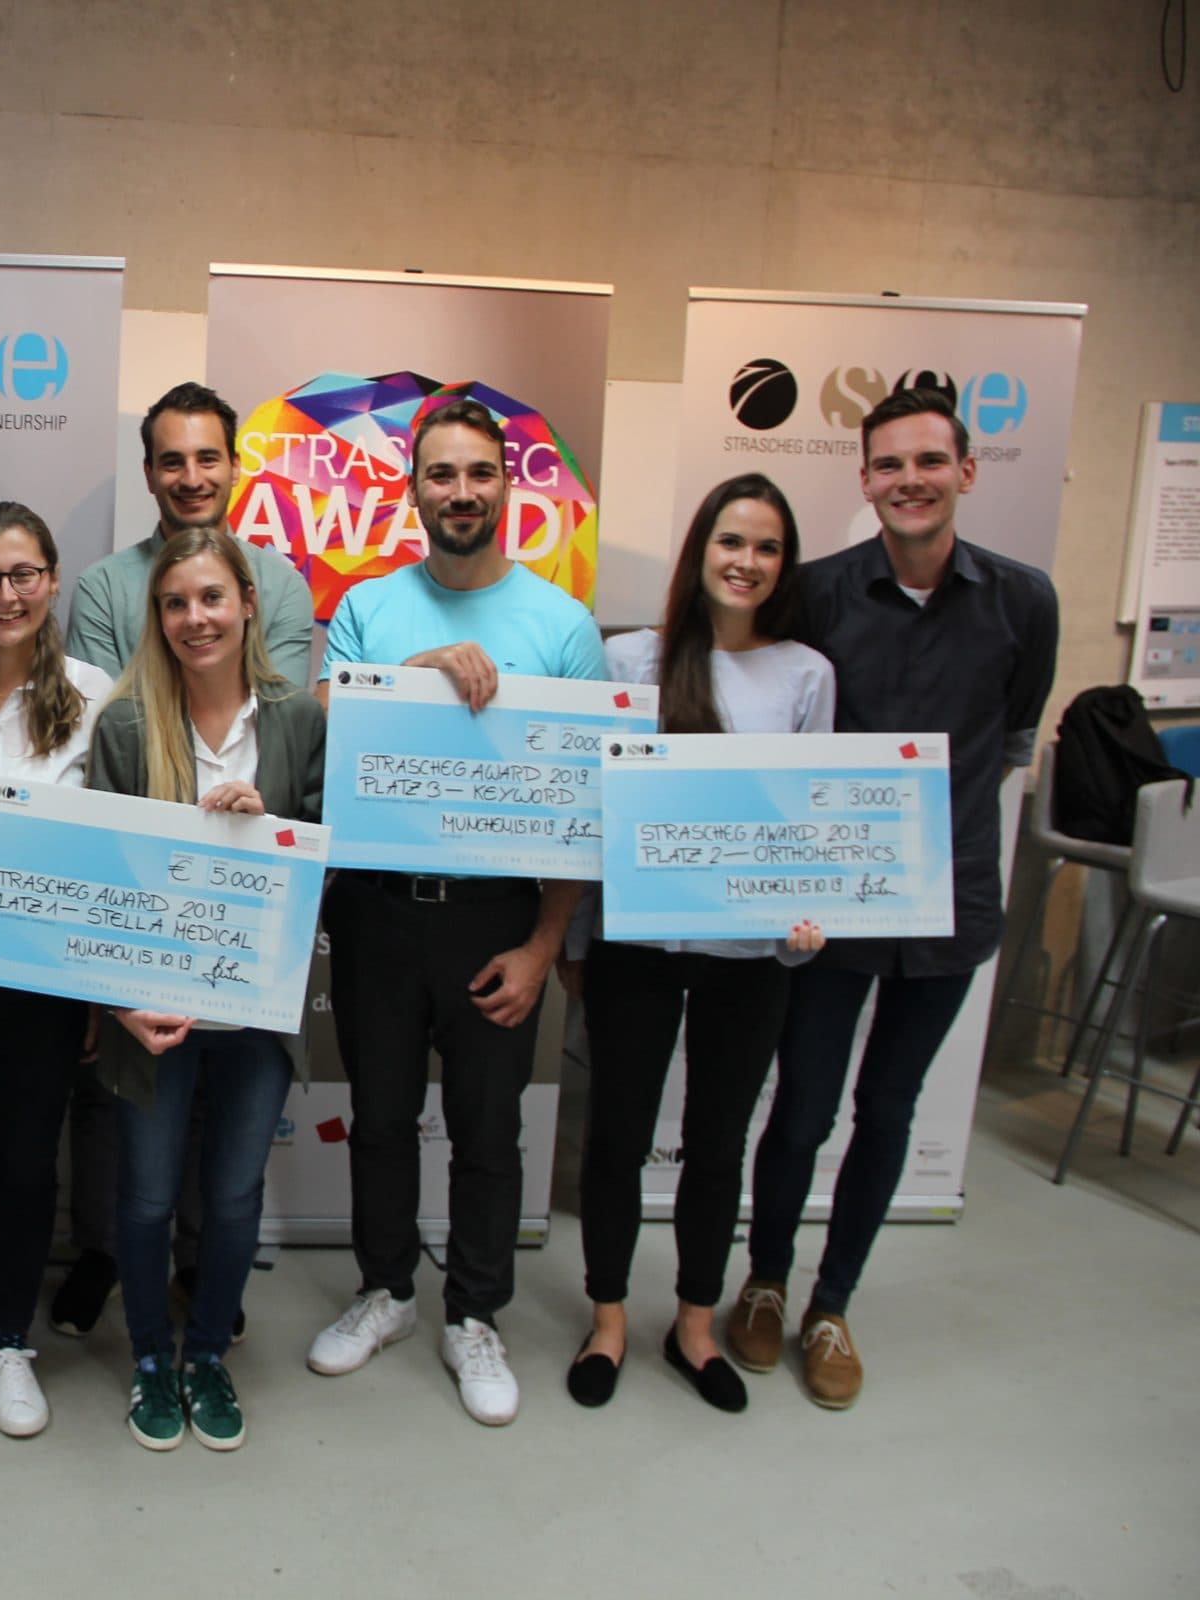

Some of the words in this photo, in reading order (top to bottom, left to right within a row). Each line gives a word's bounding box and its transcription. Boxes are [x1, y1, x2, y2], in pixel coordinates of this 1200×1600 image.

[241, 432, 559, 488] STRASEG
[724, 436, 803, 454] STRASCHEG
[807, 438, 858, 456] CENTER
[235, 482, 561, 562] AWAD
[361, 754, 466, 777] STRASCHEG
[470, 765, 541, 782] AWARD
[549, 768, 589, 785] 2019
[360, 776, 422, 796] PLATZ
[427, 780, 442, 798] 3
[473, 785, 576, 805] KEYWORD
[640, 824, 747, 842] STRASCHEG
[753, 824, 819, 842] AWARD
[827, 824, 871, 842] 2019
[640, 846, 702, 865] PLATZ
[753, 844, 897, 864] ORTHOMETRICS
[94, 886, 169, 913] AWARD
[178, 900, 226, 921] 2019
[86, 907, 163, 934] STELLA
[173, 920, 253, 950] MEDICAL
